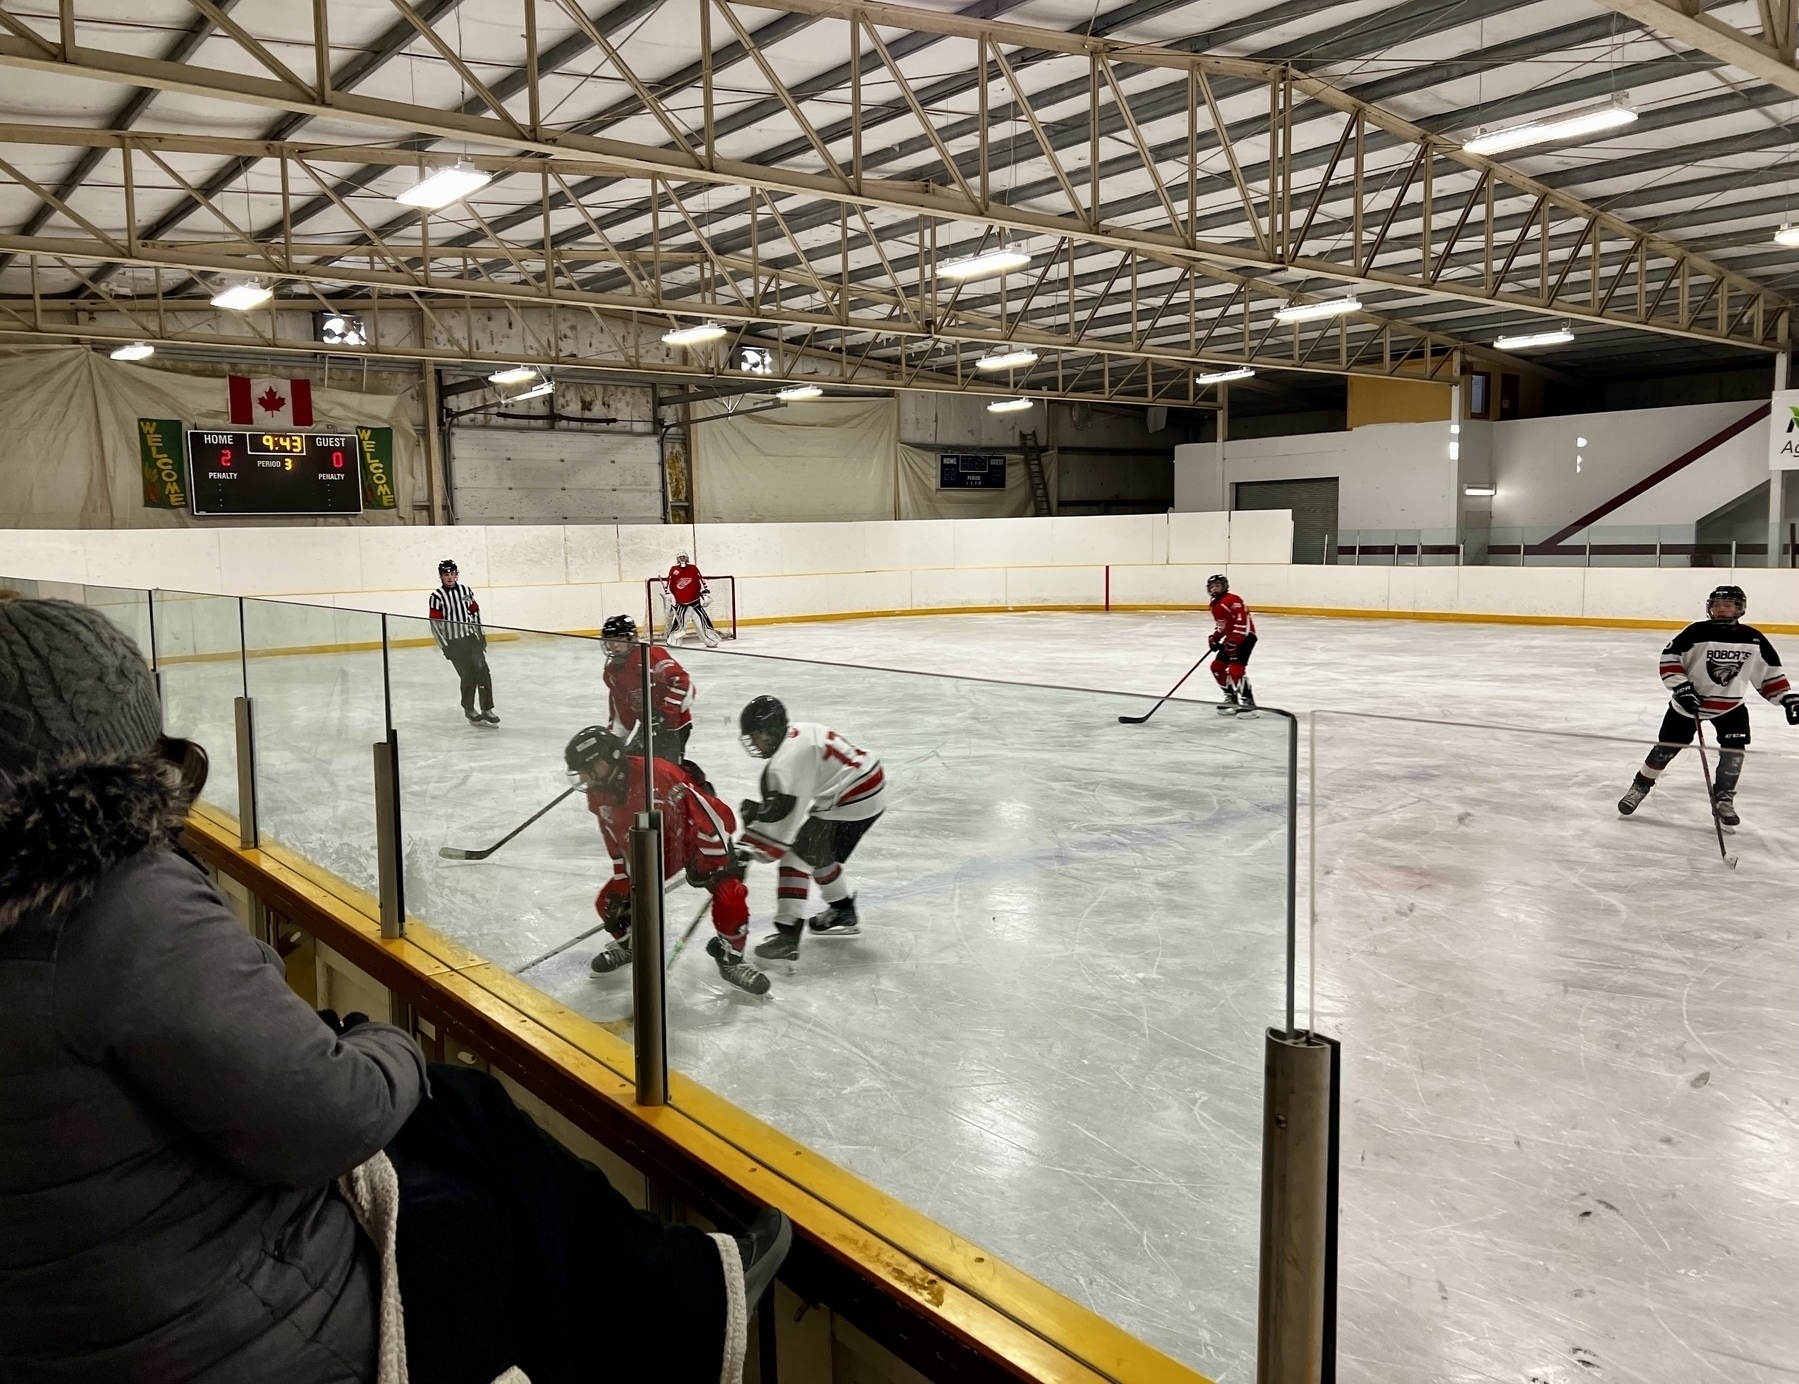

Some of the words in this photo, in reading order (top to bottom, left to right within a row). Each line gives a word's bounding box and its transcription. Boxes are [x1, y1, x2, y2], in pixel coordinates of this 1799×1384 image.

[204, 434, 234, 445] HOME
[262, 435, 302, 453] 9:43
[315, 437, 346, 447] GUEST
[140, 421, 186, 506] WELCOME
[220, 449, 232, 467] 2
[257, 460, 281, 468] PERIOD
[284, 458, 293, 471] 3
[332, 451, 344, 468] 0
[358, 428, 394, 507] WELCOME
[208, 472, 238, 480] PENALTY
[1706, 650, 1752, 660] BOBCATS
